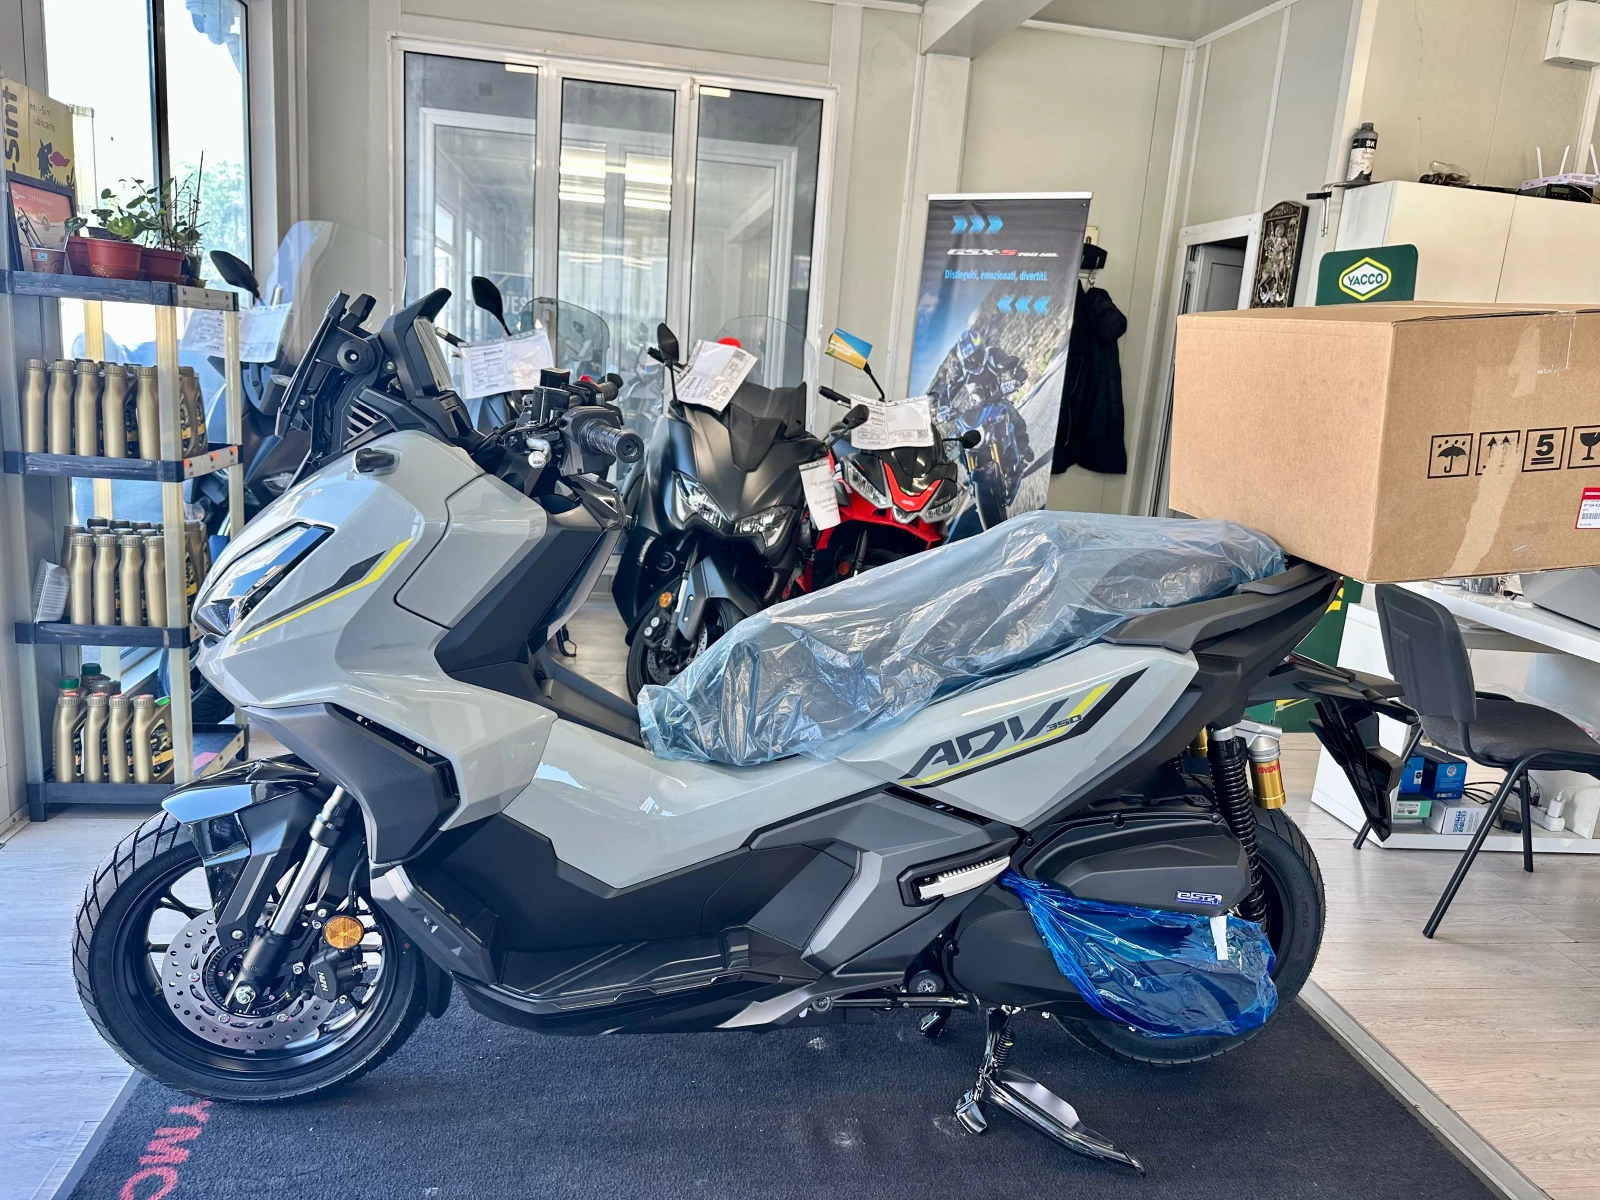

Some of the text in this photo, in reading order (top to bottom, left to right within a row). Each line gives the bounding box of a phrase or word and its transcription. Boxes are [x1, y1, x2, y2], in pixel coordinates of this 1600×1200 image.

[944, 269, 1048, 282] Distinguiti, emozionati, divertiti.
[1347, 272, 1384, 286] YACCO
[1046, 714, 1083, 733] 350
[897, 697, 1069, 780] ADV
